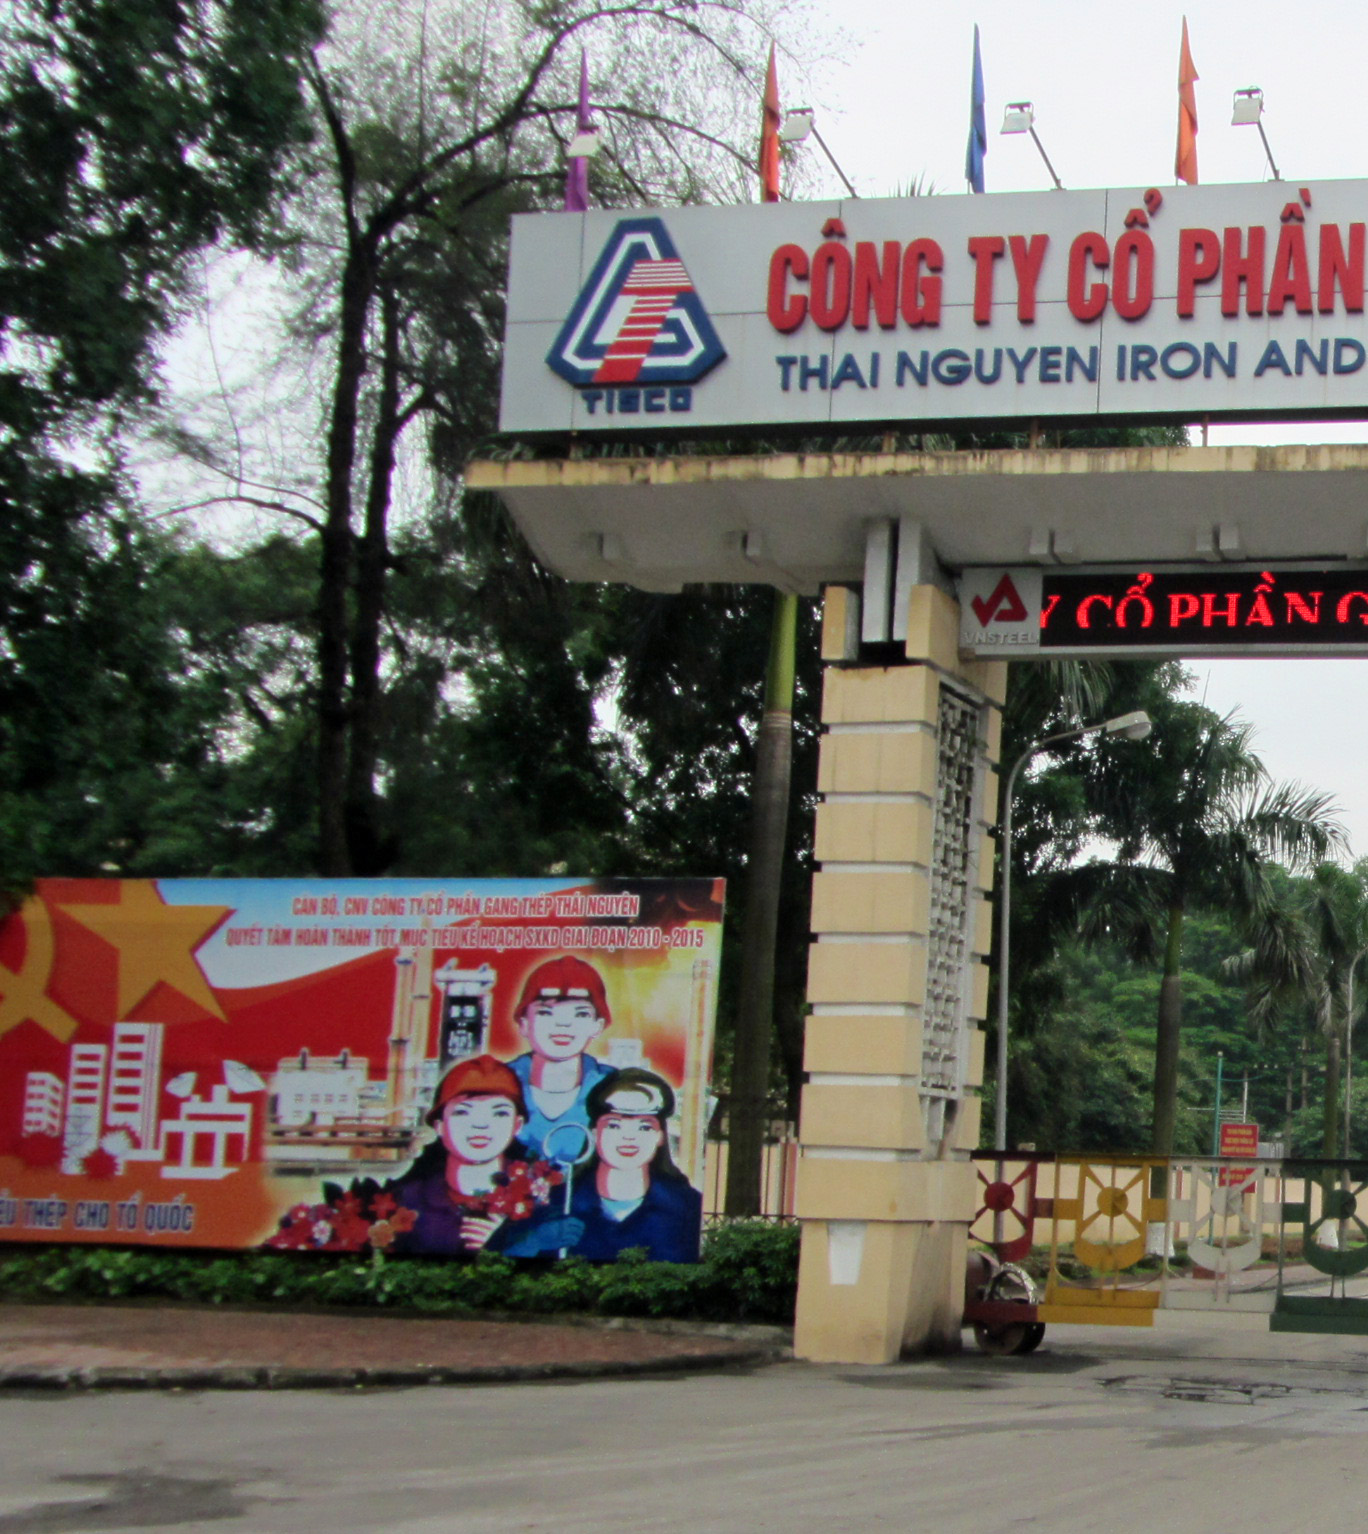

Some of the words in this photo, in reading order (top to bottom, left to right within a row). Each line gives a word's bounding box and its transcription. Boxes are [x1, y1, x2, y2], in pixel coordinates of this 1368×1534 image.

[766, 217, 944, 334] CÔNG
[967, 233, 1050, 326] TY
[1066, 187, 1163, 324] CỔ
[1176, 187, 1366, 319] PHẦN
[775, 352, 881, 392] THAI
[895, 345, 1099, 388] NGUYEN
[1116, 341, 1238, 382] IRON
[1253, 338, 1367, 377] AND
[580, 386, 693, 415] TISCO
[1166, 571, 1325, 628] PHẦN
[964, 631, 1039, 645] VNSTEEL
[344, 897, 369, 916] CNV
[371, 894, 406, 916] CÔNG
[409, 897, 423, 916] TY
[446, 890, 482, 916] PHẦN
[484, 896, 519, 917] GANG
[521, 892, 553, 917] THÉP
[555, 891, 586, 917] THÁI
[586, 890, 641, 917] NGUYÊN
[226, 921, 264, 947] QUYẾT
[267, 923, 293, 947] TÂM
[295, 924, 330, 947] HOÀN
[332, 924, 371, 947] THÀNH
[480, 926, 524, 952] HOẠCH
[525, 926, 560, 948] SXKD
[562, 926, 590, 948] GIAI
[628, 927, 662, 948] 2010
[671, 927, 705, 949] 2015
[23, 1192, 68, 1230] THÉP
[74, 1199, 110, 1231] CHO
[143, 1192, 196, 1236] QUỐC
